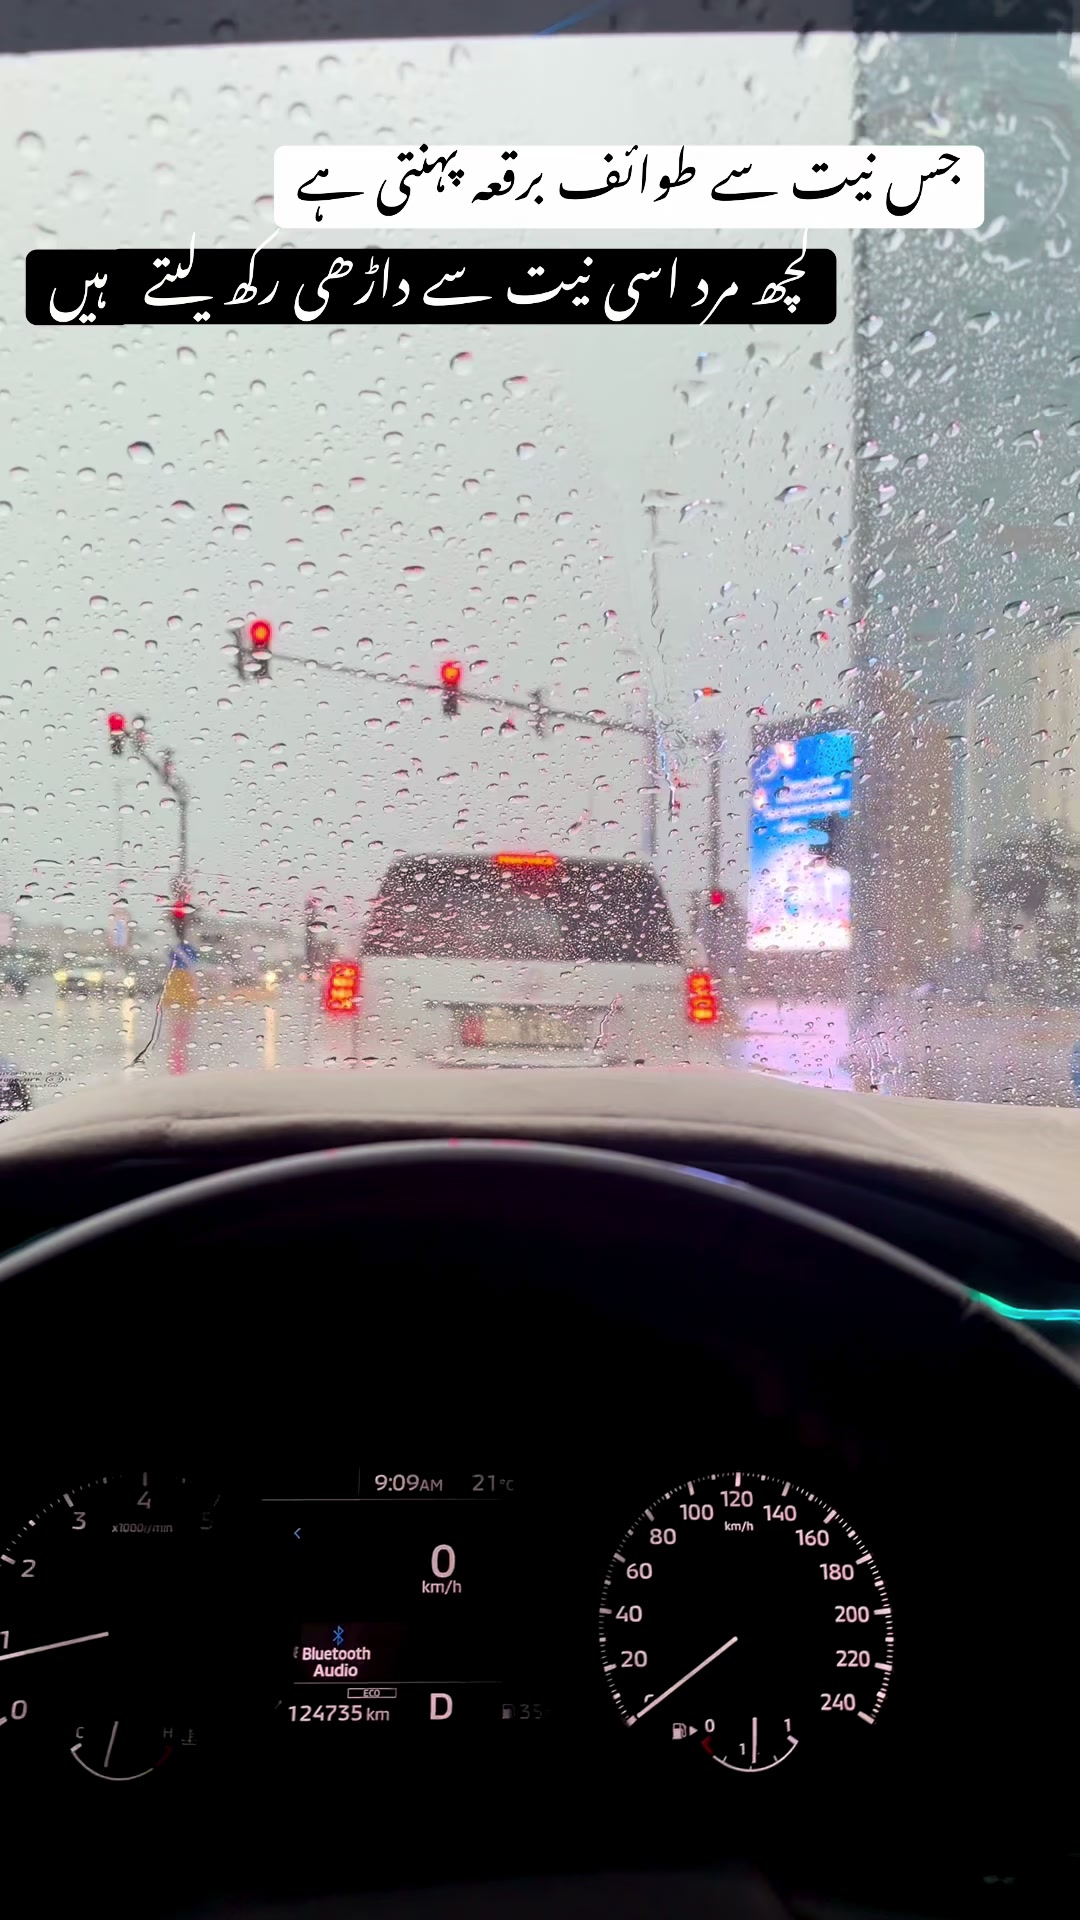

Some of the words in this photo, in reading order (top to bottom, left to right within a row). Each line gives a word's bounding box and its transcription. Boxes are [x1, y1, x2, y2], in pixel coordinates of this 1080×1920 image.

[137, 1491, 152, 1509] 4
[720, 1491, 753, 1507] 120
[680, 1504, 713, 1520] 100
[763, 1505, 796, 1521] 140
[72, 1512, 85, 1529] 3
[725, 1521, 753, 1532] km/h
[650, 1528, 676, 1544] 80
[796, 1530, 829, 1546] 160
[22, 1560, 35, 1577] 2
[432, 1544, 455, 1578] 0
[627, 1563, 652, 1579] 60
[820, 1564, 854, 1580] 180
[422, 1580, 461, 1594] km/h
[616, 1605, 642, 1622] 40
[835, 1606, 869, 1622] 200
[0, 1631, 9, 1648] 1
[303, 1647, 370, 1660] Bluetooth
[621, 1651, 647, 1667] 20
[836, 1650, 870, 1667] 220
[313, 1663, 358, 1677] Audio
[363, 1689, 380, 1697] ECO
[12, 1700, 27, 1719] 0
[430, 1693, 452, 1720] D
[821, 1694, 855, 1711] 240
[289, 1705, 362, 1721] 124735
[367, 1708, 389, 1720] km
[75, 1727, 84, 1739] C
[163, 1727, 173, 1738] H
[705, 1719, 715, 1732] 0
[784, 1719, 790, 1732] 1
